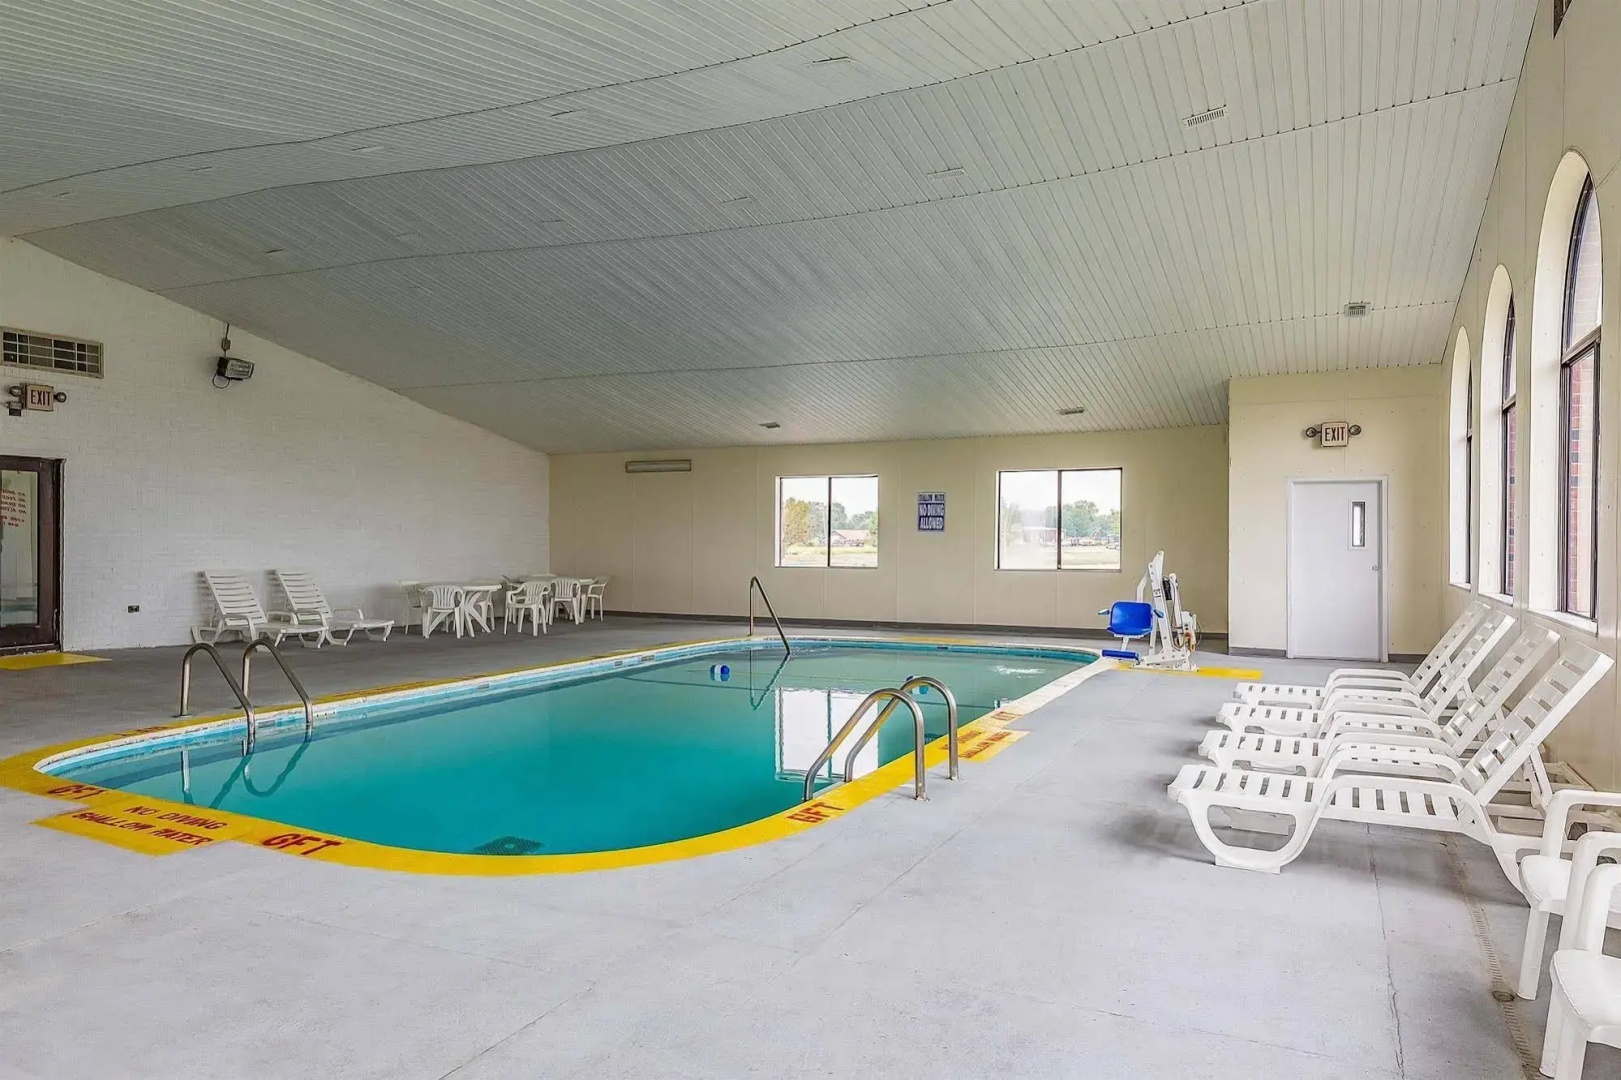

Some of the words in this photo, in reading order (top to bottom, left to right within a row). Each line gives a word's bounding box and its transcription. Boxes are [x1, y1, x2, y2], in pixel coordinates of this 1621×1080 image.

[31, 390, 51, 406] EXIT
[1325, 427, 1345, 441] EXIT
[920, 504, 927, 516] NO
[927, 504, 944, 516] DIVING
[920, 517, 943, 530] ALLOWED
[123, 805, 157, 816] NO
[156, 812, 227, 830] DIVING
[72, 812, 155, 831] SHALLOW
[150, 828, 214, 845] WATER
